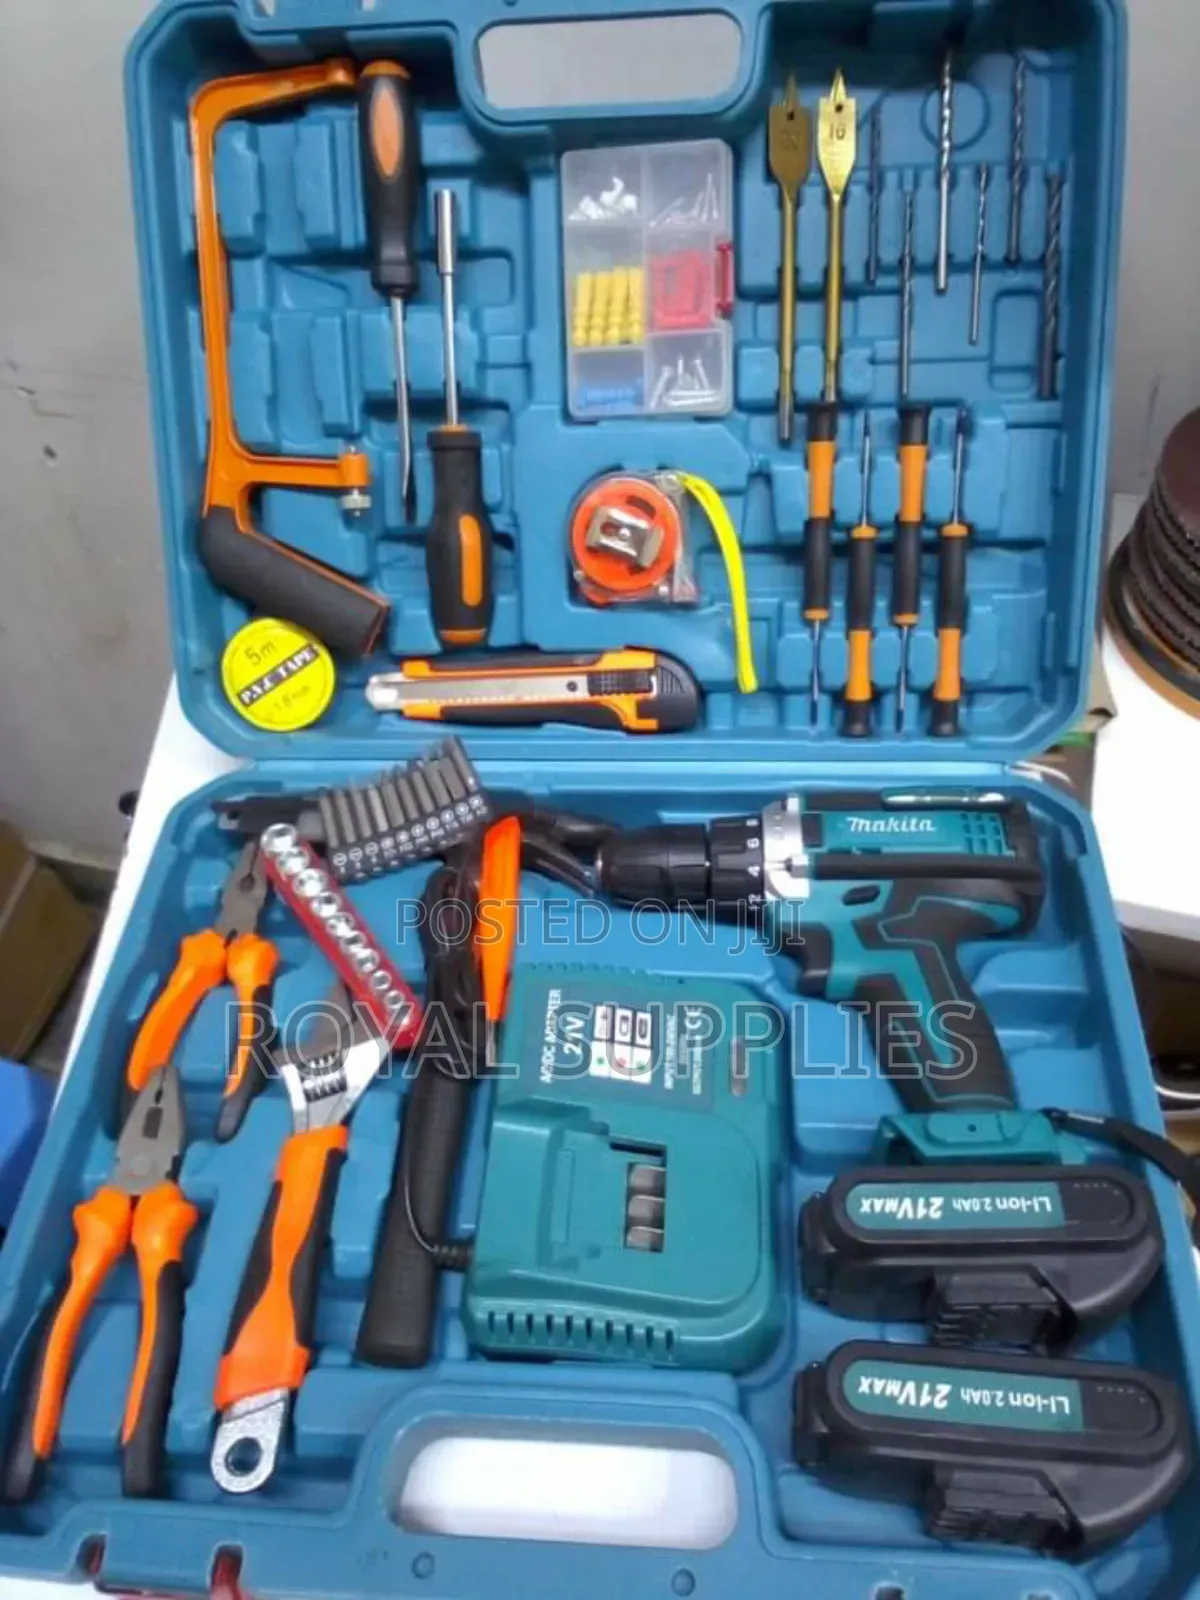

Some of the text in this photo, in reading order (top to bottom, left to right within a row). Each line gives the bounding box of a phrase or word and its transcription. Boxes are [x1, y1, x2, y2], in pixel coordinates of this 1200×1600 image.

[830, 121, 846, 140] 16
[277, 645, 319, 678] TAPE
[563, 1015, 586, 1055] 21V
[960, 1387, 1002, 1408] 2.0Ah
